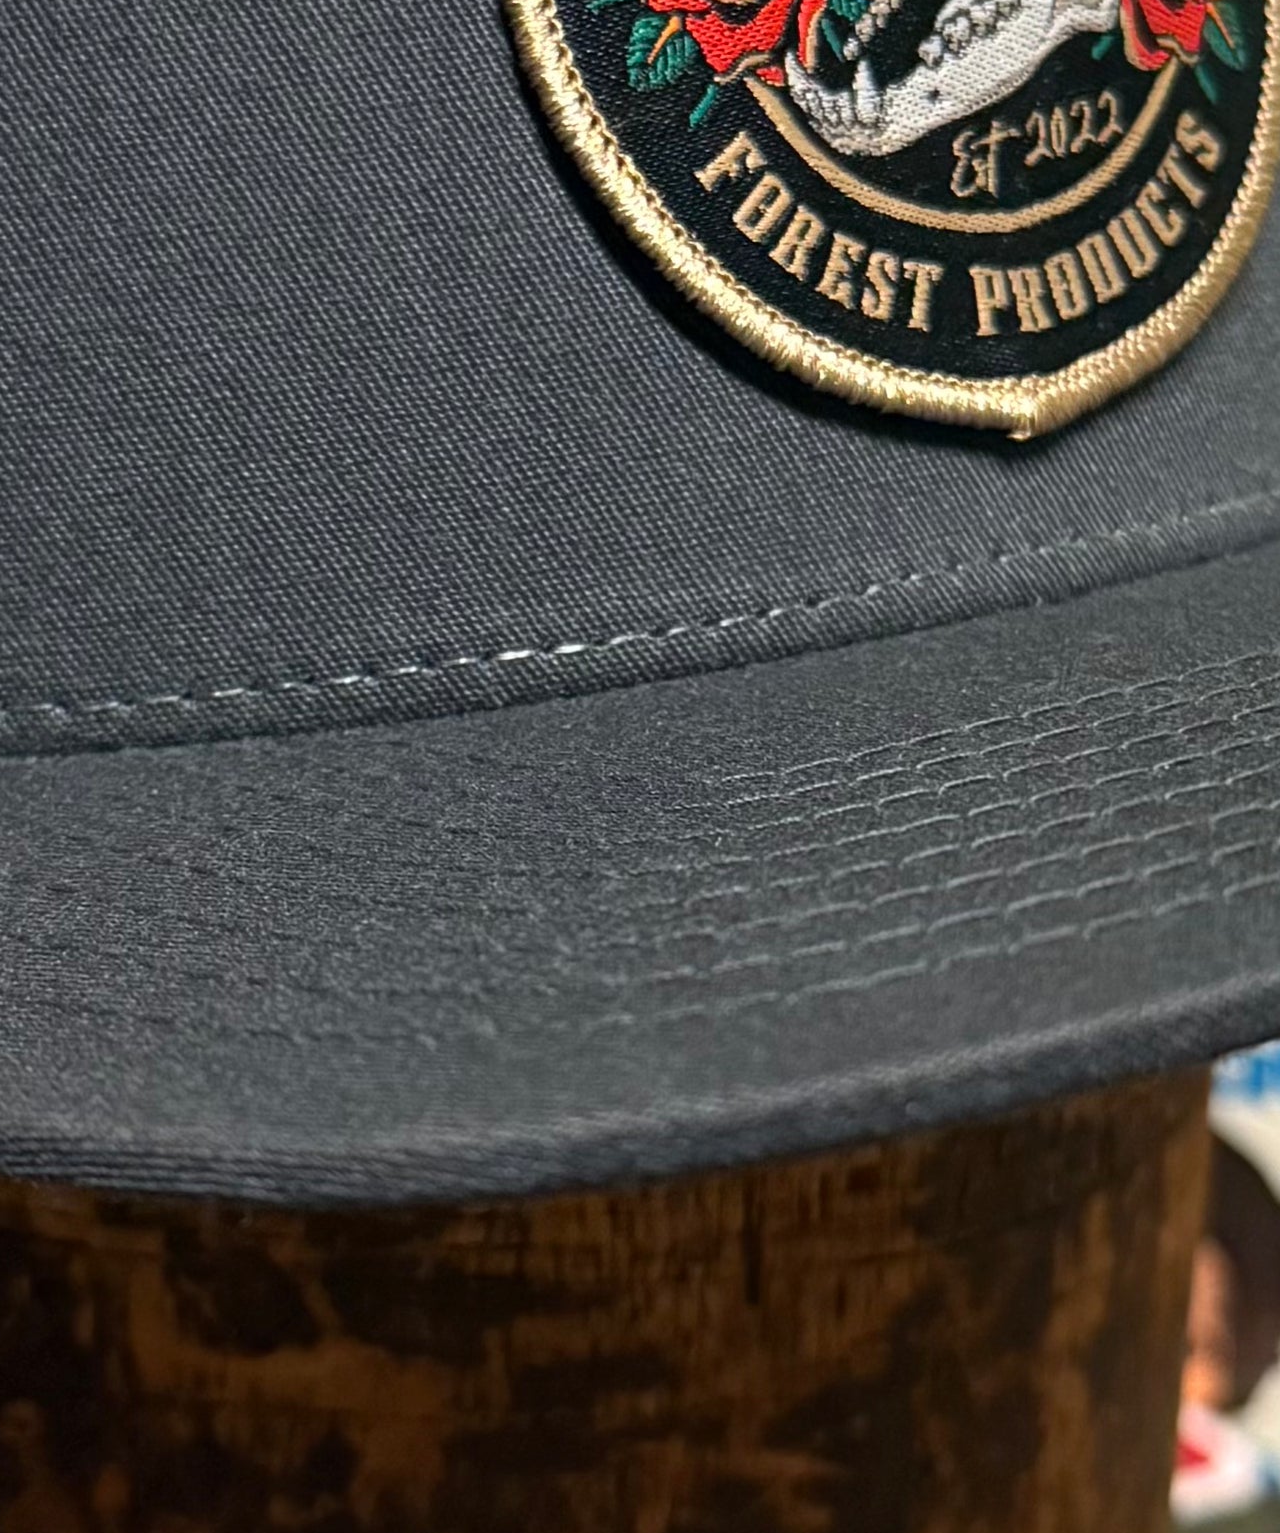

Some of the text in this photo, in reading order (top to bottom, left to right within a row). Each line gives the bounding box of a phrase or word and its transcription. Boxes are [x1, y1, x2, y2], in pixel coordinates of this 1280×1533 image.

[1023, 88, 1124, 166] 2022
[692, 130, 945, 333] FOREST
[967, 109, 1228, 337] PRODUCTS
